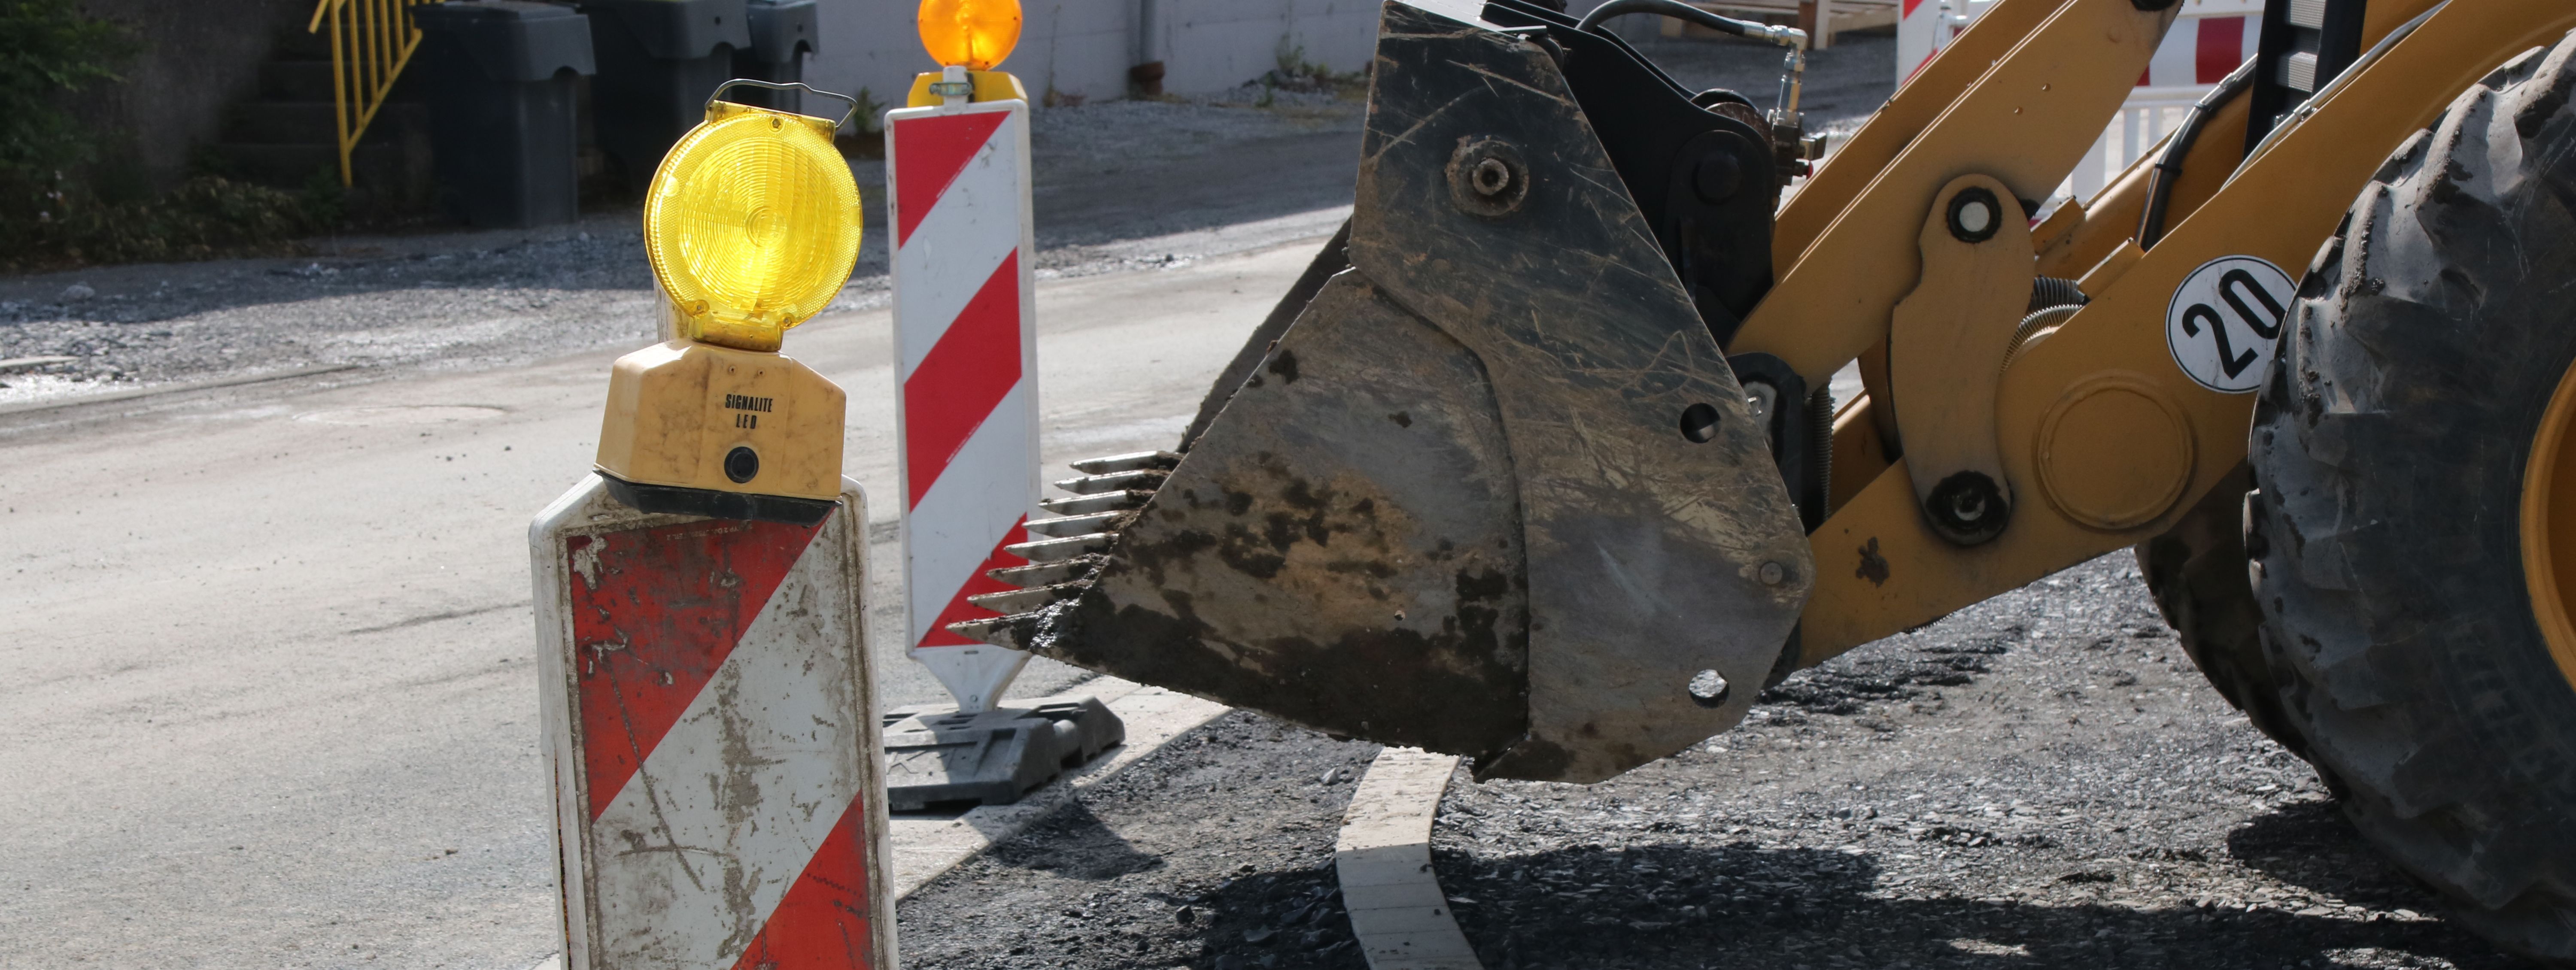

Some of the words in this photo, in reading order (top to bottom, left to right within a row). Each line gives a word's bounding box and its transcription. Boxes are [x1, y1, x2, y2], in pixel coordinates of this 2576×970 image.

[2182, 269, 2286, 379] 20
[725, 394, 773, 412] SIGNALITE
[736, 414, 757, 429] LED
